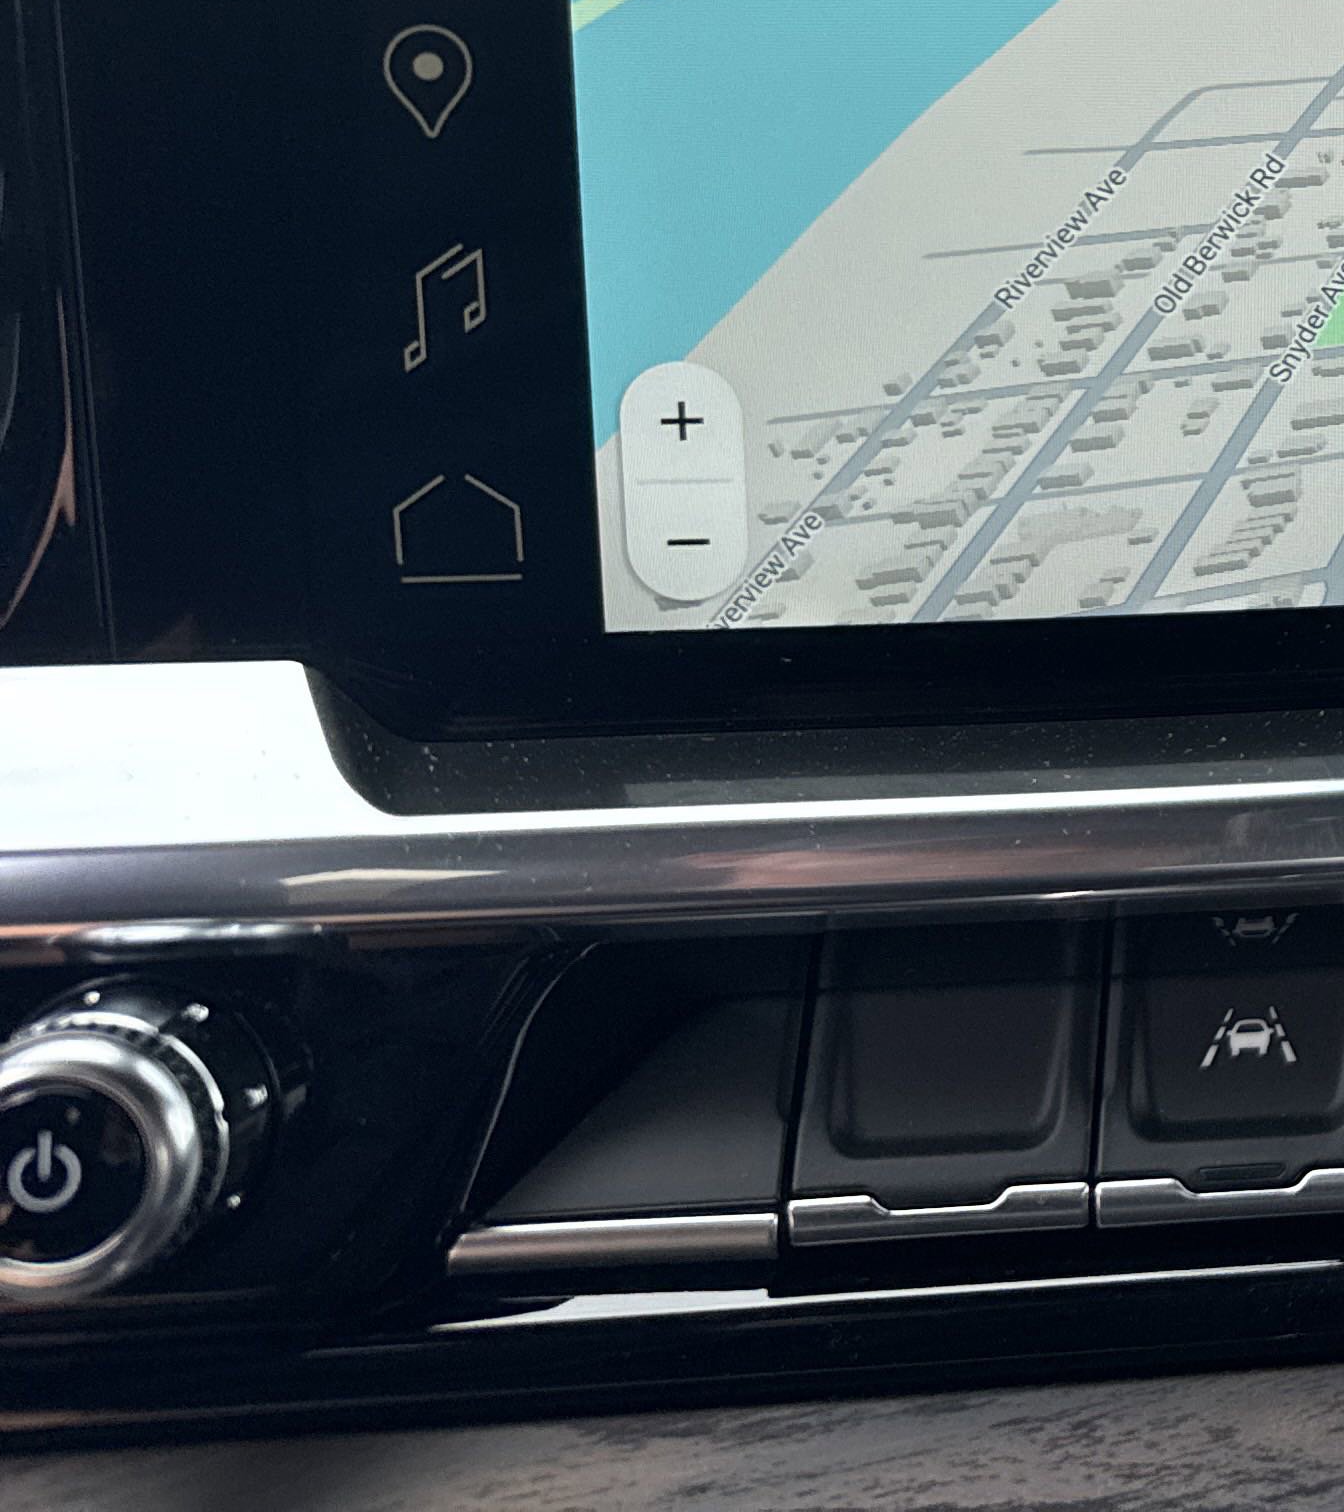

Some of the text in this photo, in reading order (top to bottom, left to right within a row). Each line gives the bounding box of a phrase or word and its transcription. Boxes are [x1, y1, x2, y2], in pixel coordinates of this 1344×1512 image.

[993, 167, 1128, 310] Riverview Ave
[1153, 152, 1286, 315] Old Berwick Rd
[1268, 304, 1332, 384] Snyder
[780, 513, 823, 558] Ave
